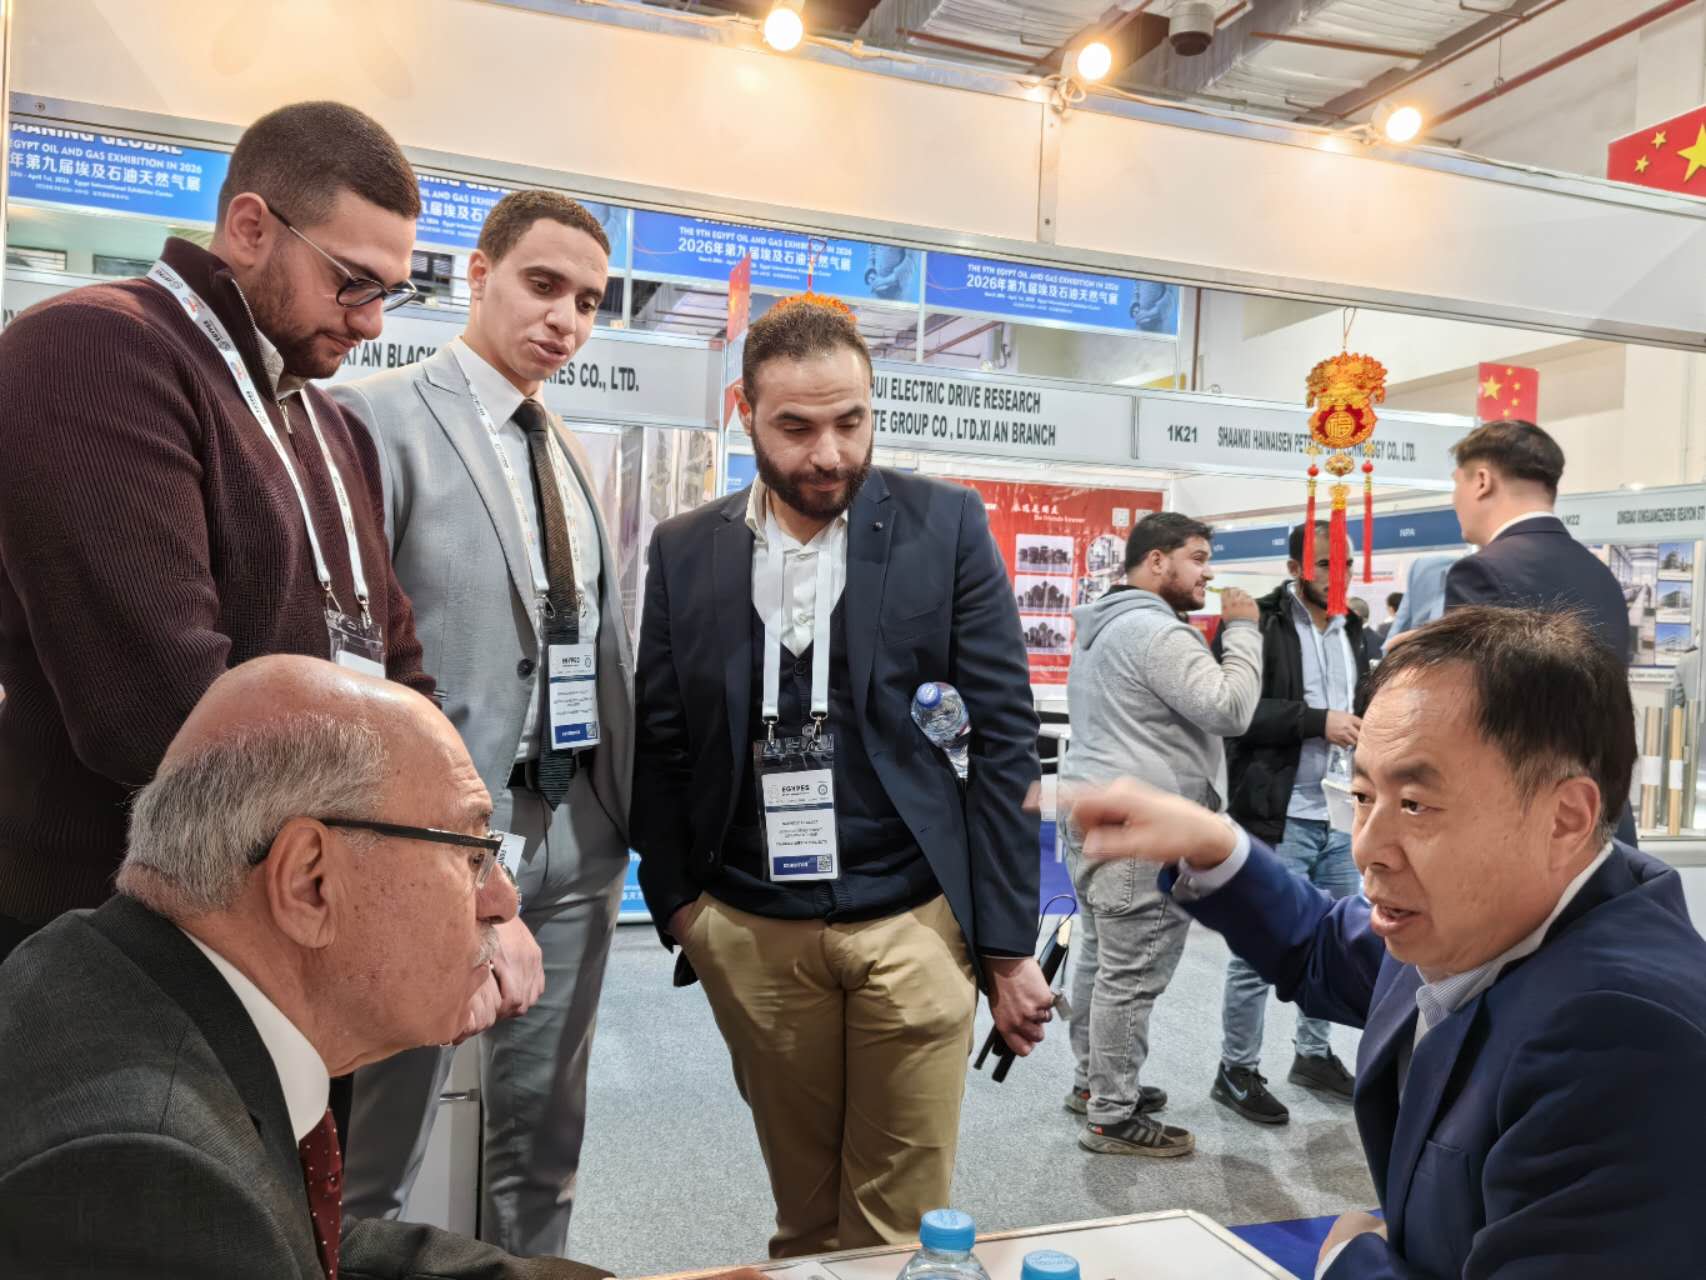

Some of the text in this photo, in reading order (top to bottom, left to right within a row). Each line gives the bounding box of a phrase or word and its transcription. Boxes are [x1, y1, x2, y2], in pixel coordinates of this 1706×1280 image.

[42, 143, 59, 154] OIL
[61, 147, 83, 157] AND
[85, 149, 105, 160] GAS
[107, 152, 164, 168] EXHIBITION
[166, 160, 177, 170] IN
[180, 162, 202, 174] 2026
[432, 190, 451, 200] AND
[452, 193, 469, 203] GAS
[680, 226, 694, 236] THE
[712, 230, 736, 241] EGYPT
[750, 236, 766, 245] AND
[768, 237, 782, 247] GAS
[968, 264, 981, 273] THE
[611, 366, 639, 392] LTD.
[891, 378, 945, 404] ELECTRIC
[948, 384, 981, 408] DRIVE
[984, 388, 1041, 413] RESEARCH
[890, 411, 929, 435] GROUP
[1012, 422, 1056, 446] BRANCH
[1167, 425, 1197, 443] 1K21
